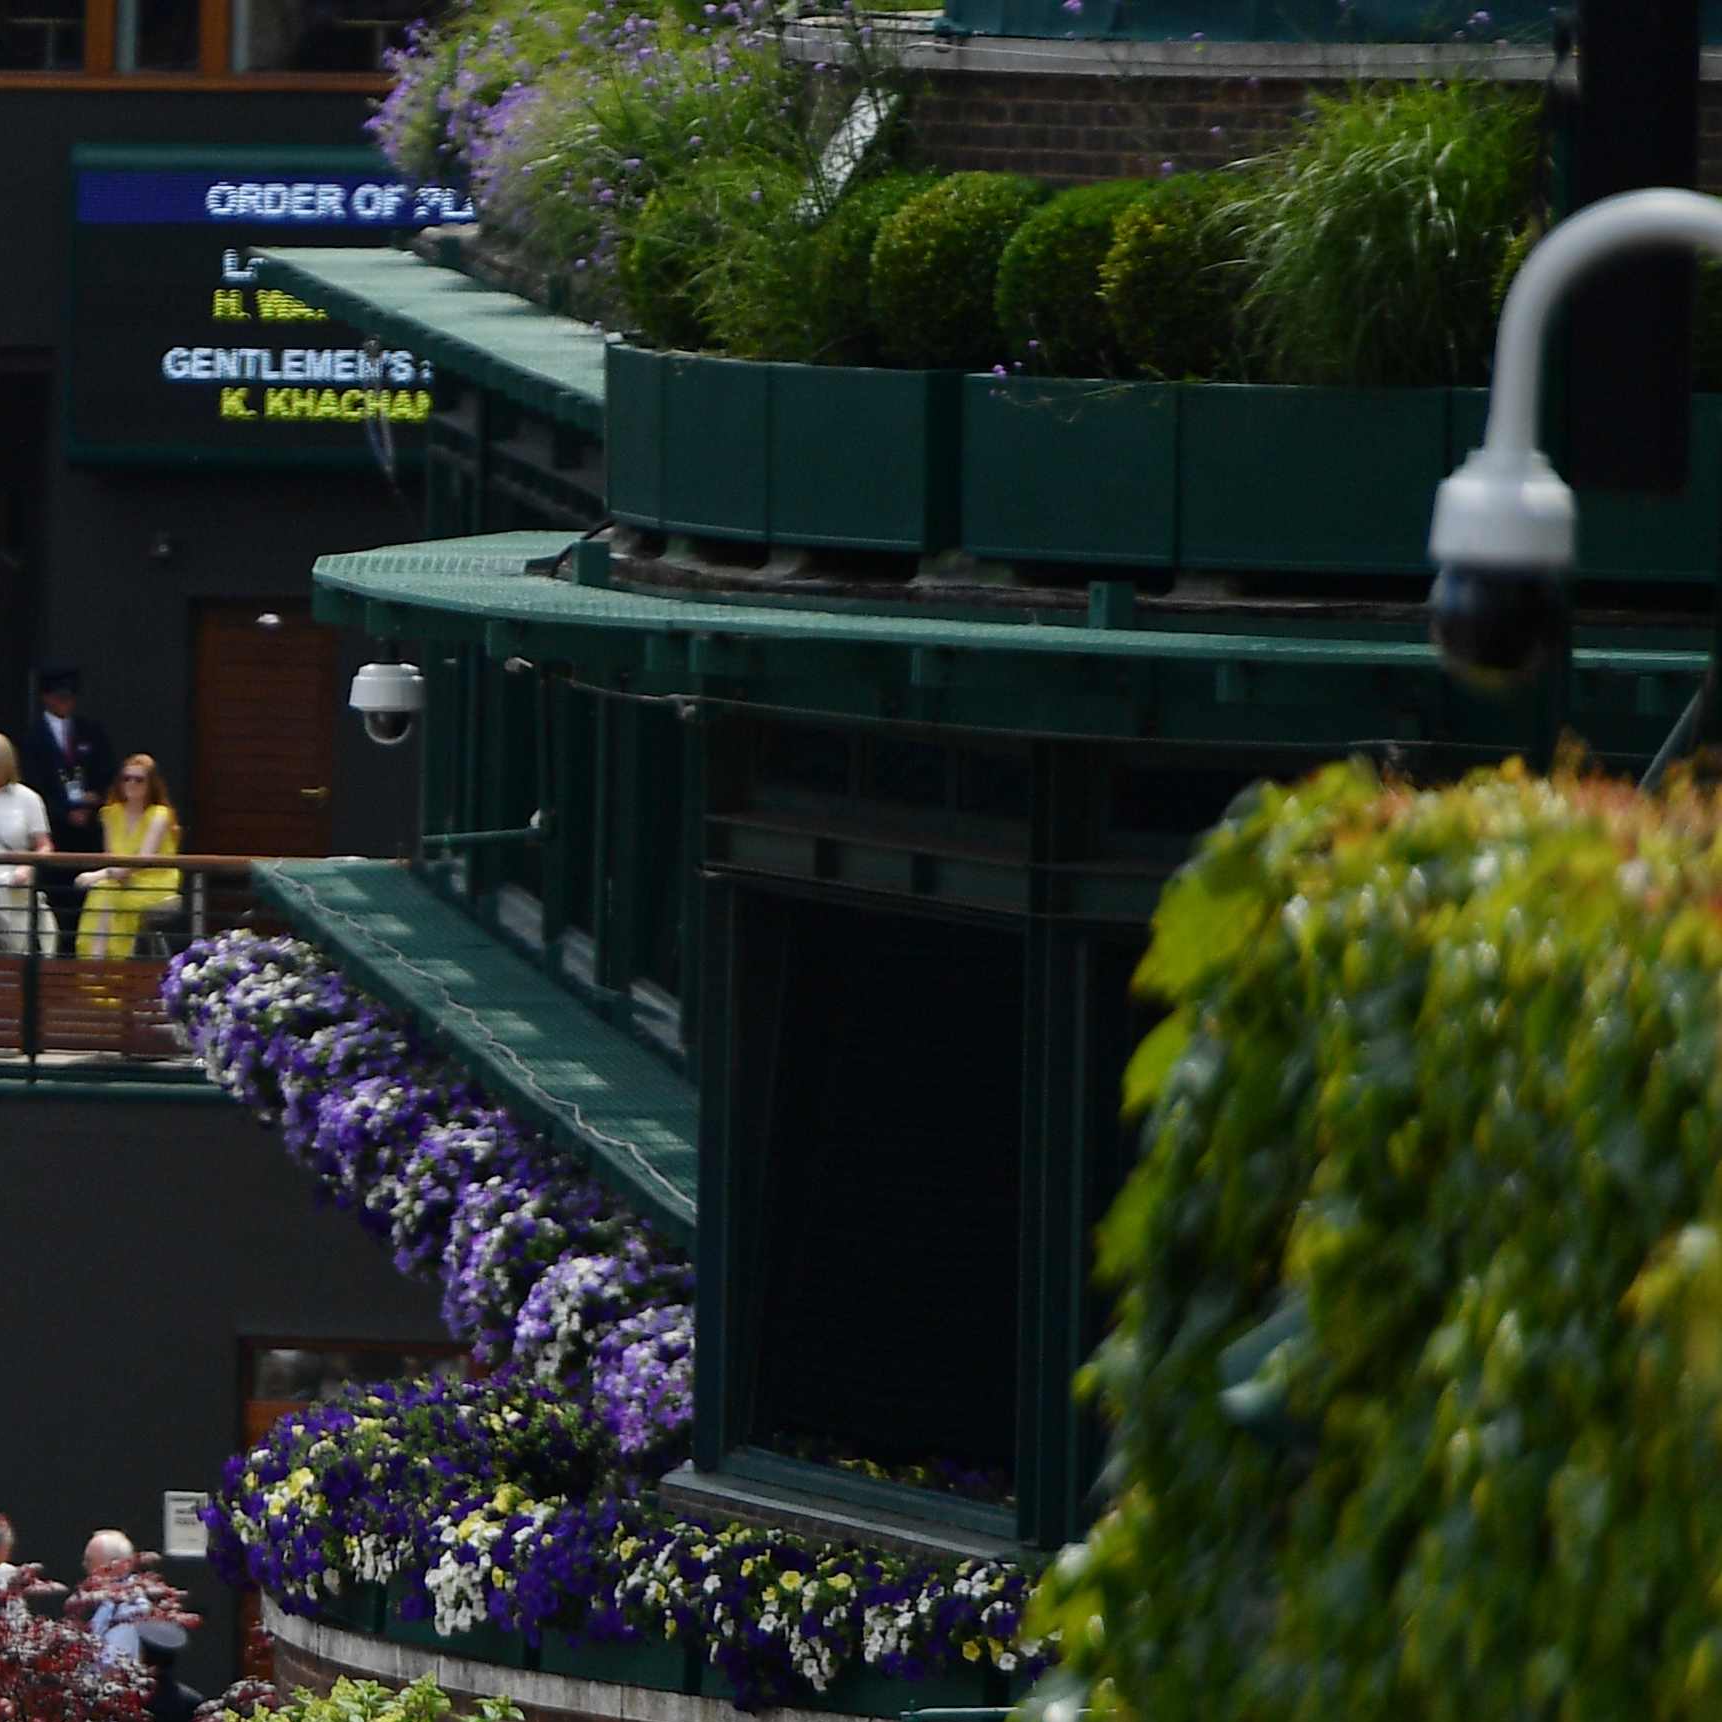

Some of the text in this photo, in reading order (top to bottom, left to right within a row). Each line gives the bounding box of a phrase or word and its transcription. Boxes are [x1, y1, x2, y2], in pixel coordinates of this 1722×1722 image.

[206, 183, 346, 218] ORDER
[353, 184, 406, 219] OF
[162, 348, 414, 382] GENTLEMEN'S
[220, 388, 256, 420] K.
